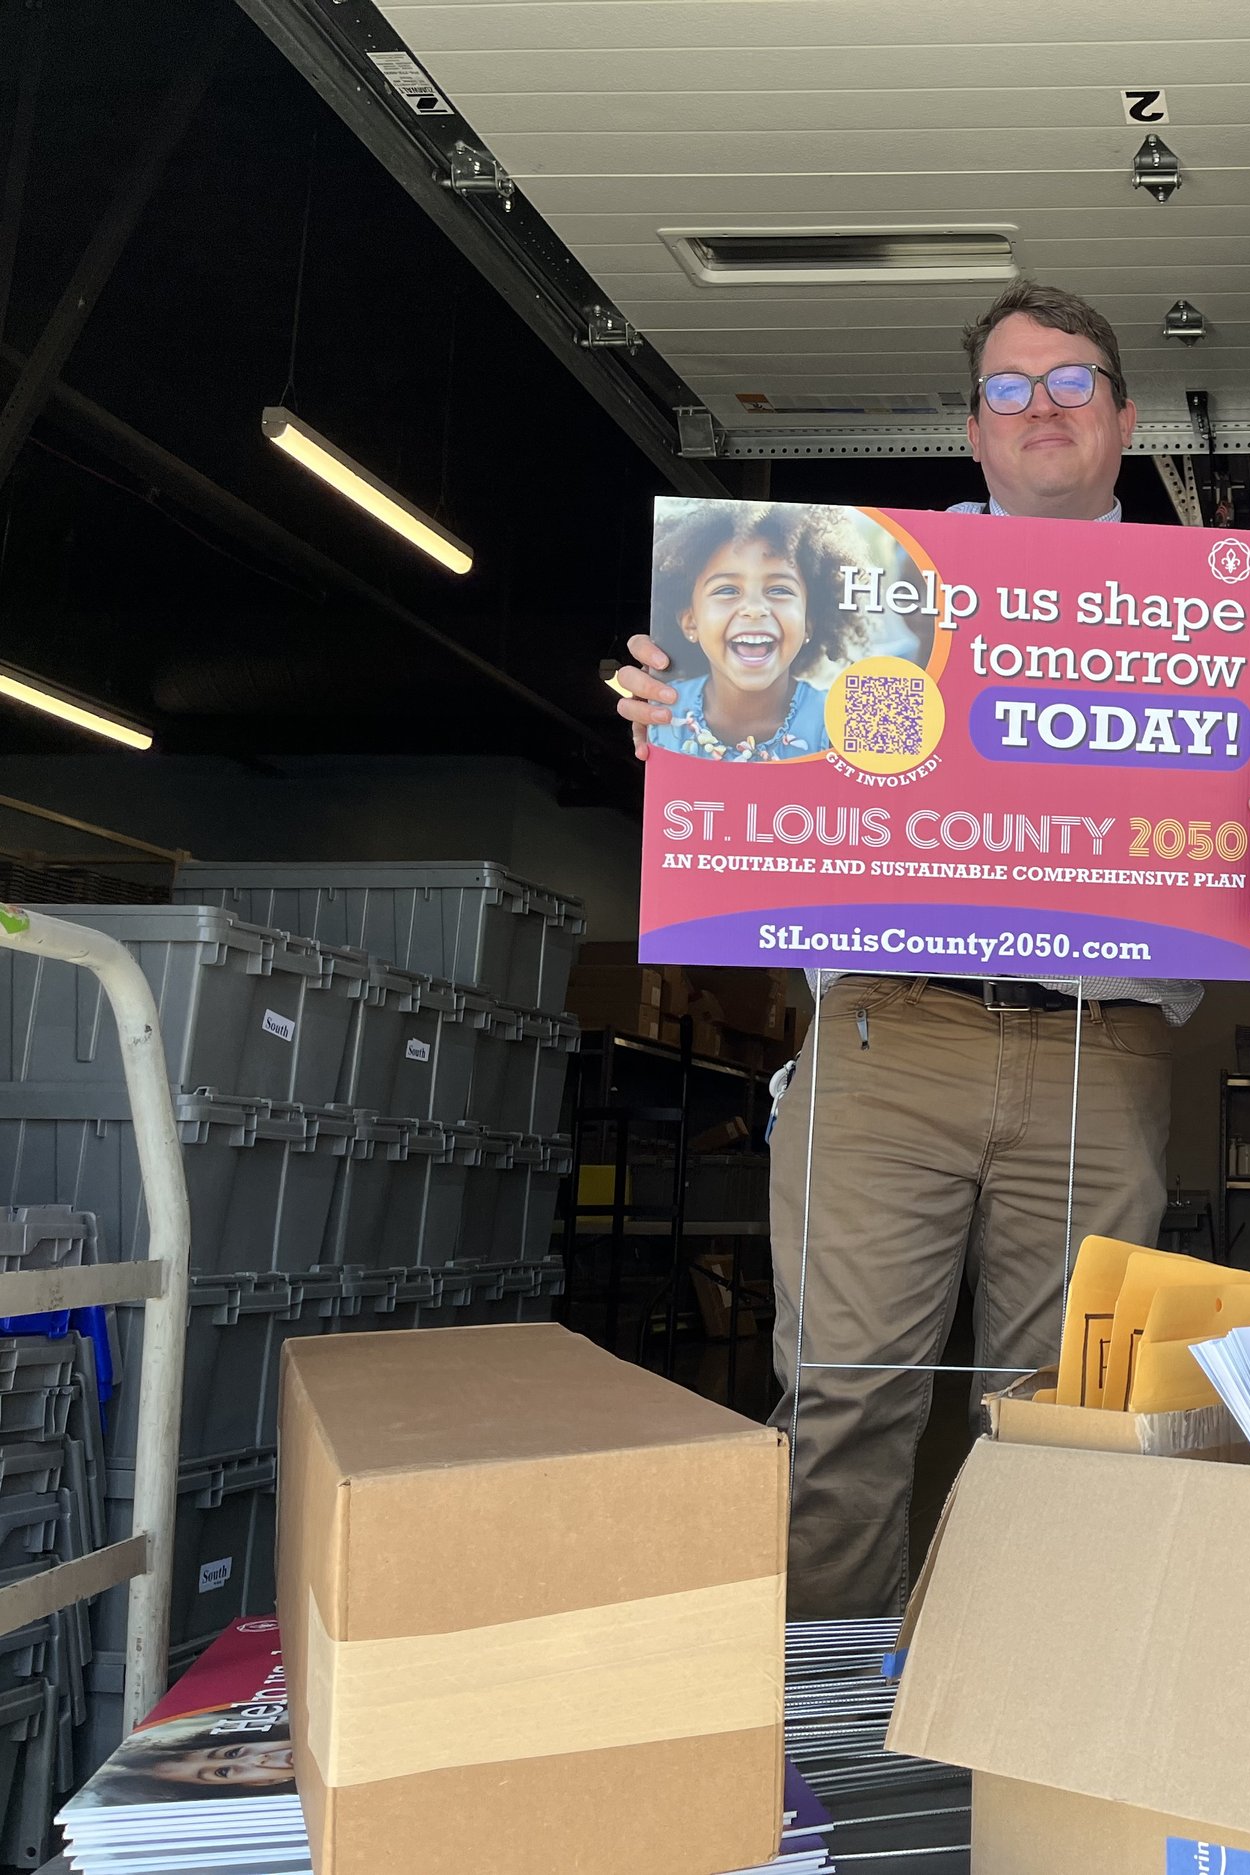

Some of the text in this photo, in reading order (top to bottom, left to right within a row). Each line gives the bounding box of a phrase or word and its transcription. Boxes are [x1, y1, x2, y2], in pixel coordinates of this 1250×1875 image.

[1125, 91, 1164, 122] 2
[838, 565, 1246, 642] Help us shape
[969, 633, 1247, 689] tomorrow
[994, 700, 1239, 757] TODAY!
[826, 751, 943, 788] GET INVOLVED!
[662, 799, 1249, 862] ST. LOUIS COUNTY 2050
[662, 852, 1247, 889] AN EQUITABLE AND SUSTAINABLE COMPREHENSIVE PLAN
[759, 924, 1152, 963] StLouisCounty2050.com
[265, 1016, 289, 1038] South
[408, 1045, 426, 1059] South
[202, 1565, 227, 1584] South
